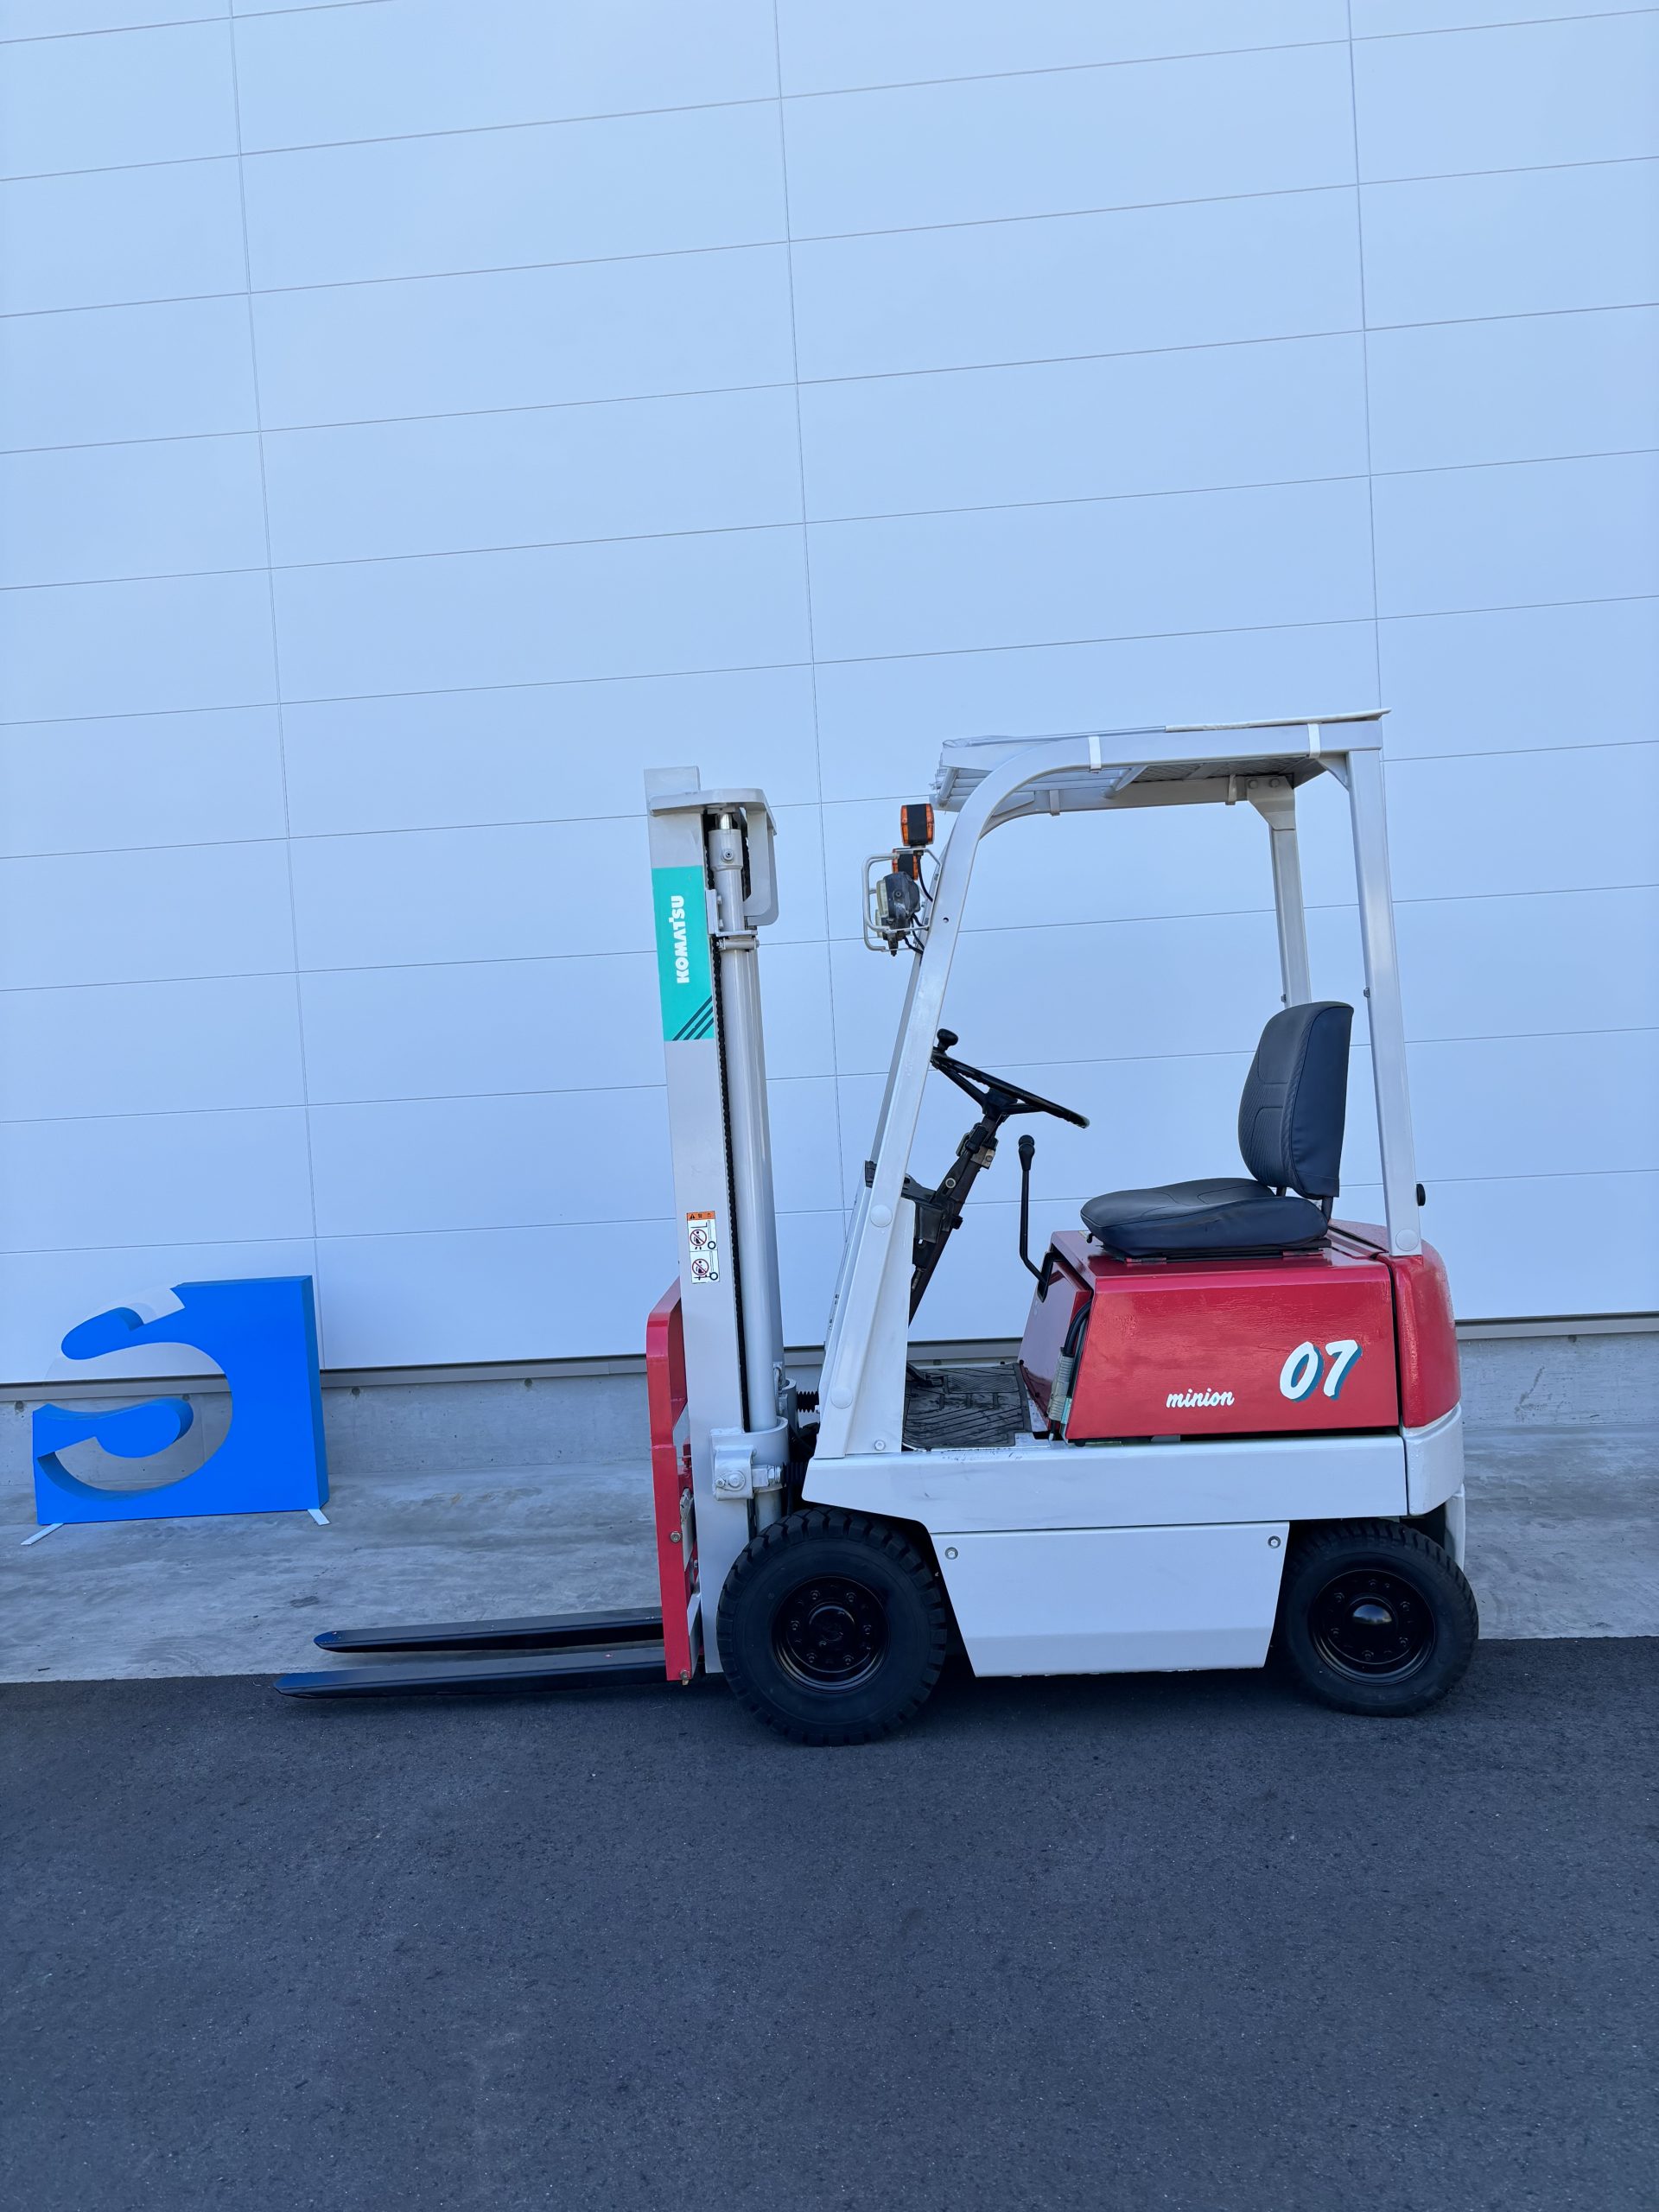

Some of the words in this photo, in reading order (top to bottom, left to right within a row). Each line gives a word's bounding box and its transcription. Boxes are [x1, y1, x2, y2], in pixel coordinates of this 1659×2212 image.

[668, 895, 690, 983] KOMATSU
[1166, 1388, 1235, 1408] minion
[1279, 1339, 1363, 1401] 07
